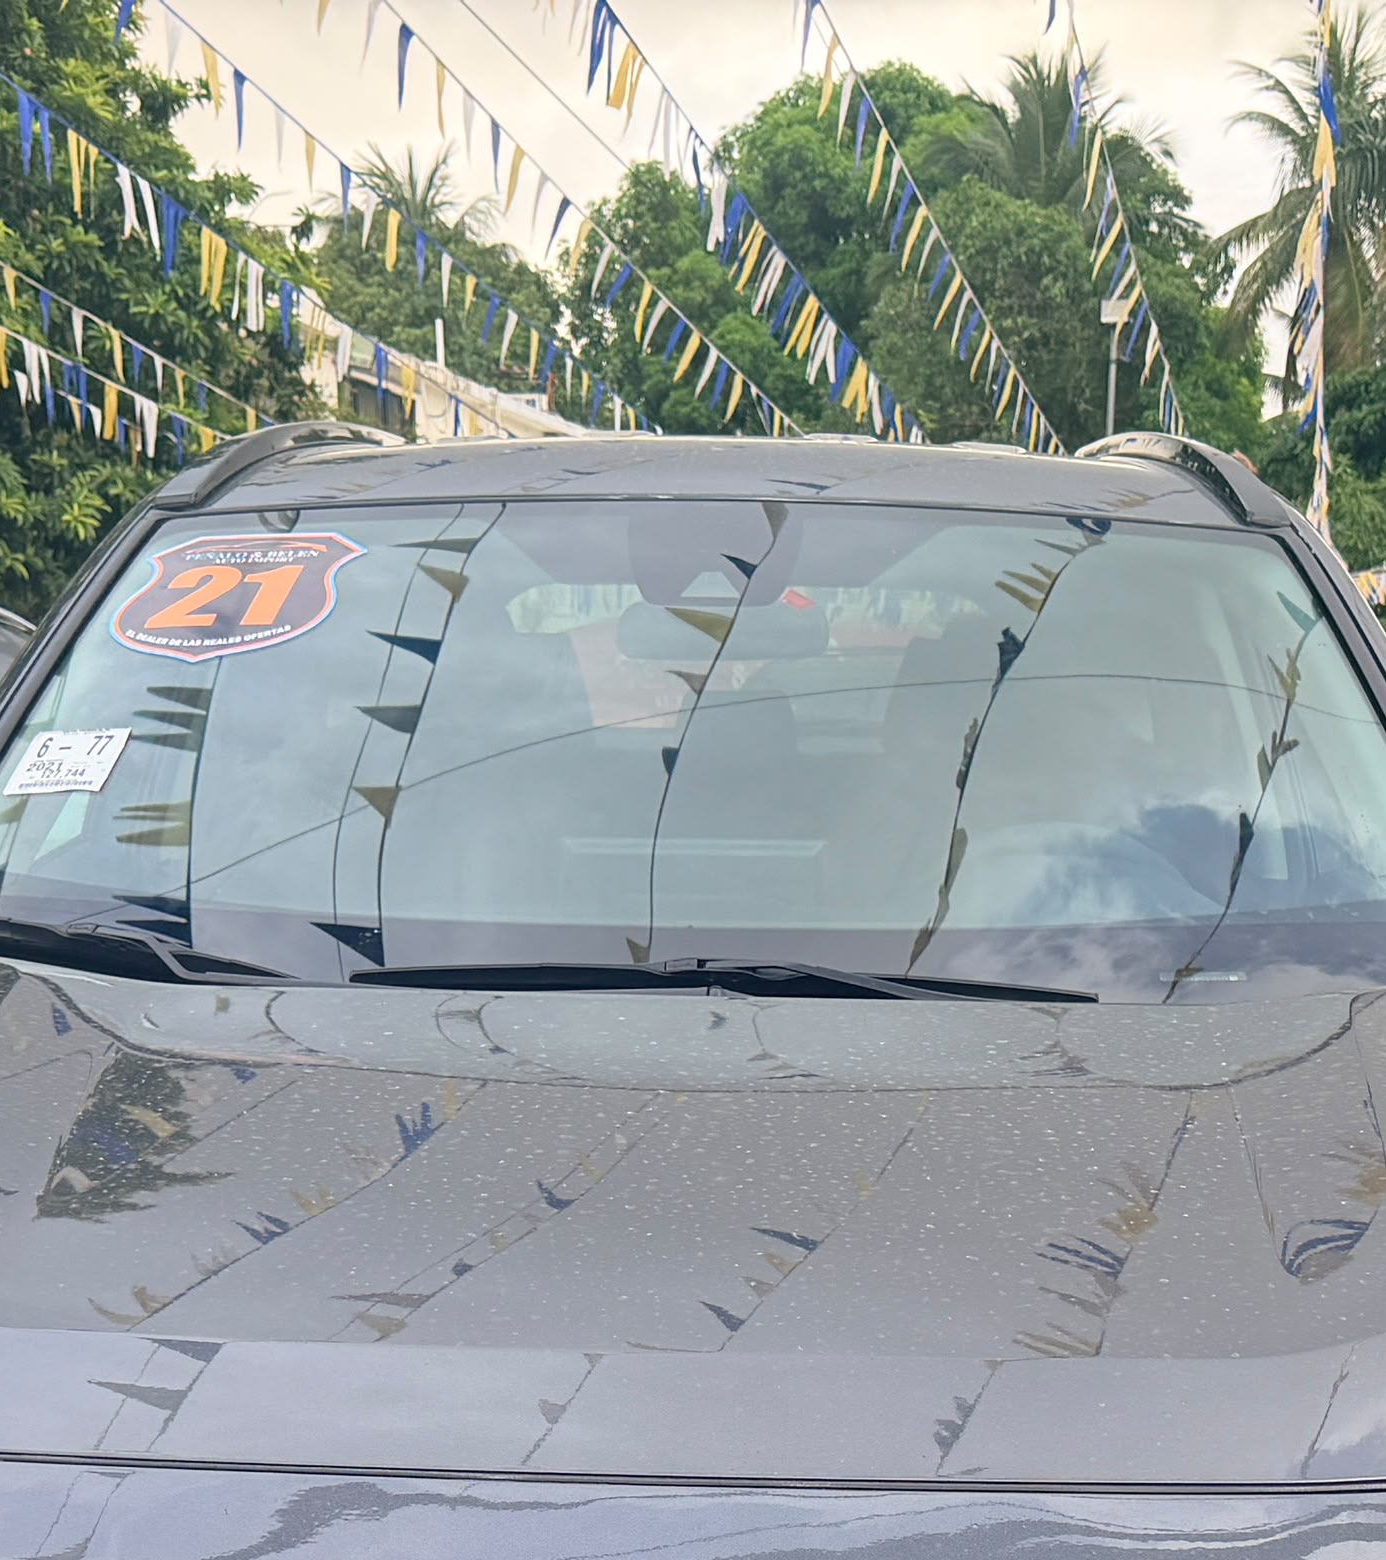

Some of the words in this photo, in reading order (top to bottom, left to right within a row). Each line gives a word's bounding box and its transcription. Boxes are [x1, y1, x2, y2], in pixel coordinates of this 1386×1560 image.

[143, 564, 304, 630] 21
[124, 628, 135, 638] EL
[136, 631, 167, 645] DEALER
[169, 638, 182, 646] DE
[183, 638, 202, 647] LAS
[203, 636, 242, 647] REALES
[243, 624, 292, 642] OFERTAS
[37, 737, 54, 758] 6
[86, 735, 115, 756] 77
[26, 761, 63, 773] 2021
